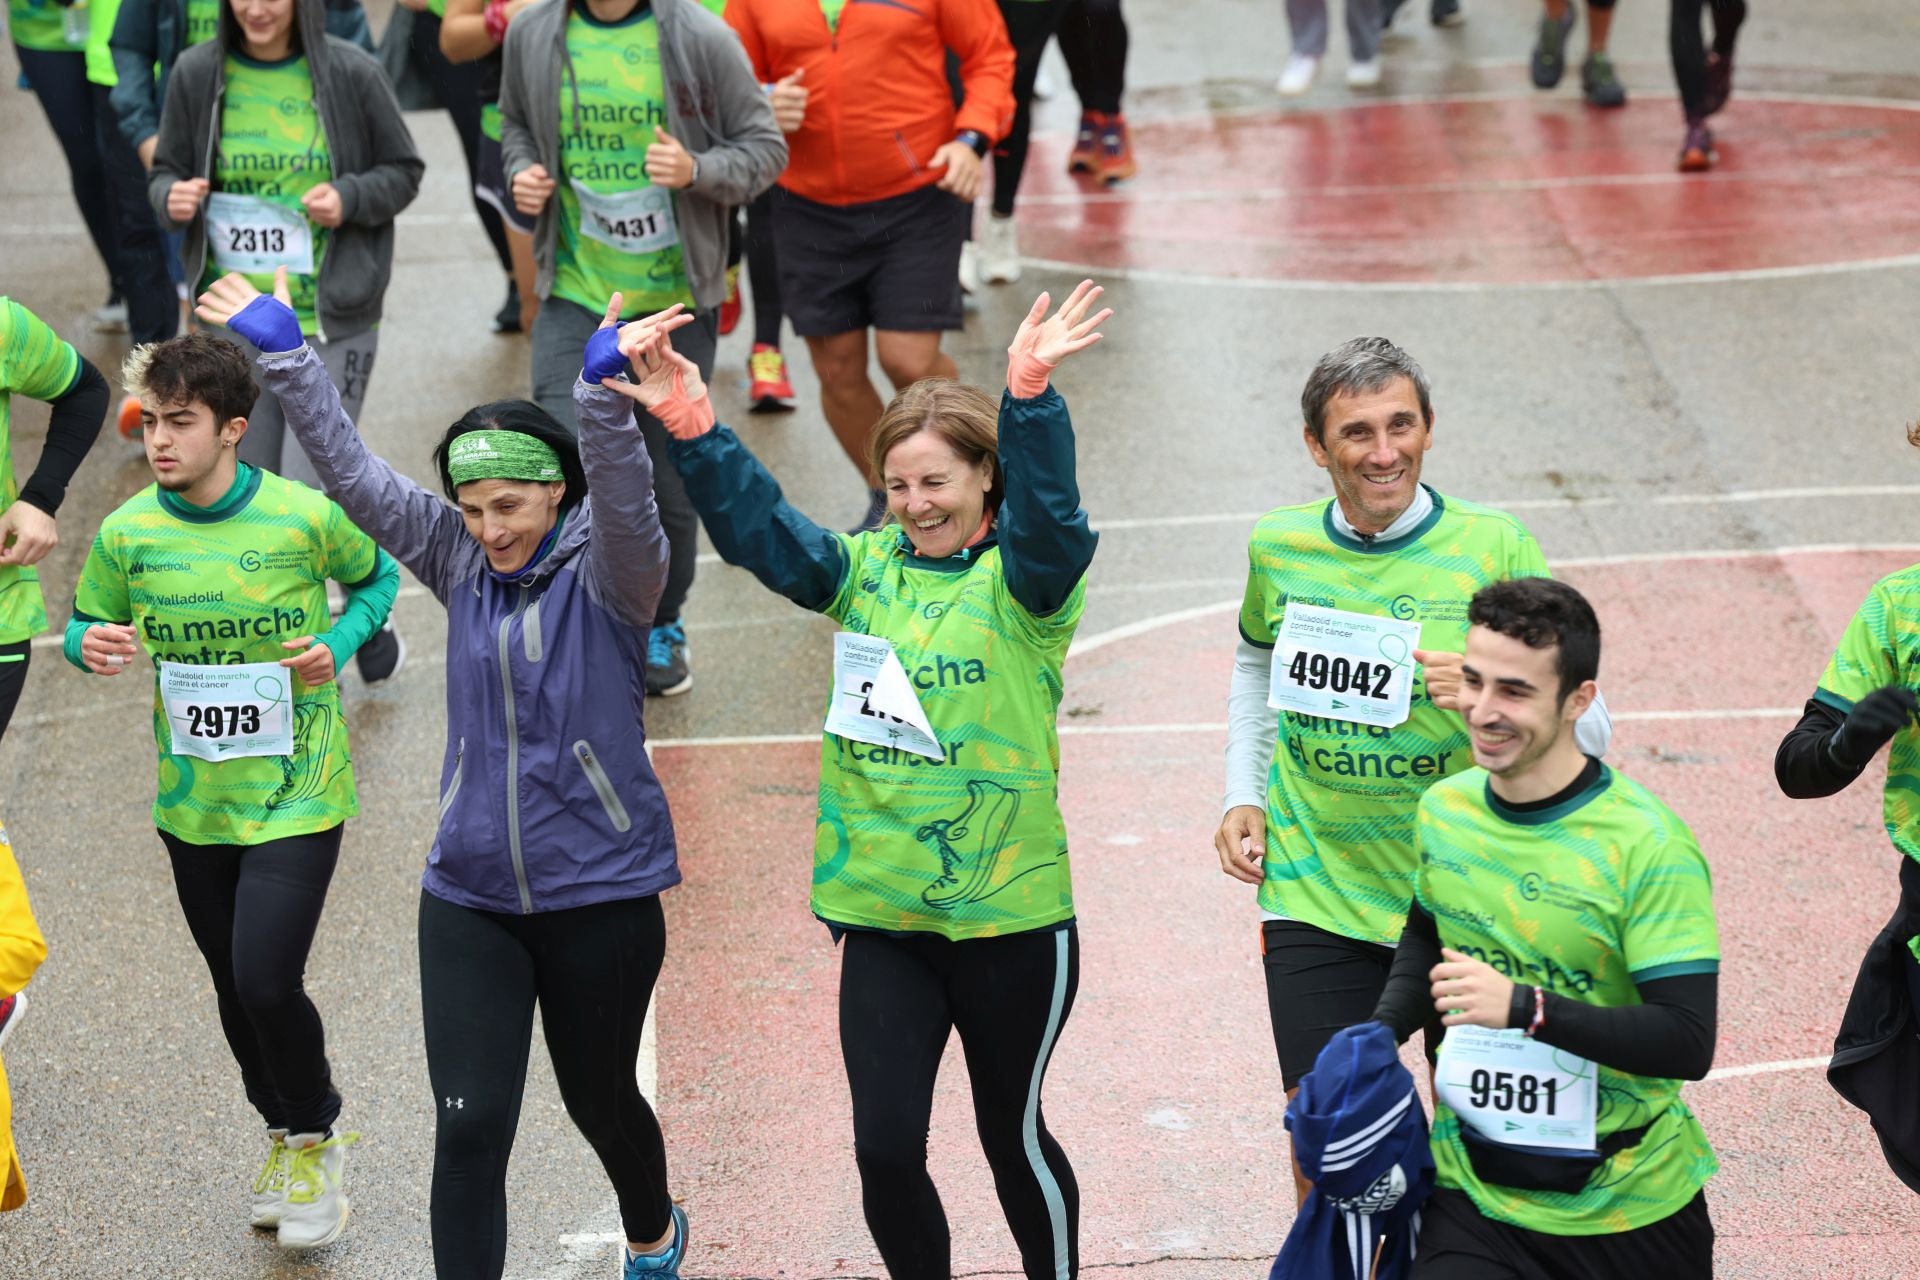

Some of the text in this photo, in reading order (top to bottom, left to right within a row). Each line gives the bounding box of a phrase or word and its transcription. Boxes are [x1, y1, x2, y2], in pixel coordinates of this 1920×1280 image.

[578, 99, 668, 125] march
[231, 150, 331, 172] march
[230, 226, 285, 252] 2313
[157, 591, 224, 606] Valladolid
[143, 607, 305, 642] En marcha
[1290, 622, 1314, 633] contra
[1316, 624, 1324, 633] el
[1292, 611, 1377, 633] Valladolid en marcha
[844, 651, 868, 662] contra
[845, 641, 884, 655] Valladolid
[168, 679, 190, 688] contra
[169, 669, 204, 680] Valladolid
[218, 672, 250, 680] marcha
[1289, 650, 1392, 700] 49042
[187, 704, 260, 739] 2973
[1288, 734, 1452, 778] el cáncer
[1470, 1069, 1557, 1116] 9581
